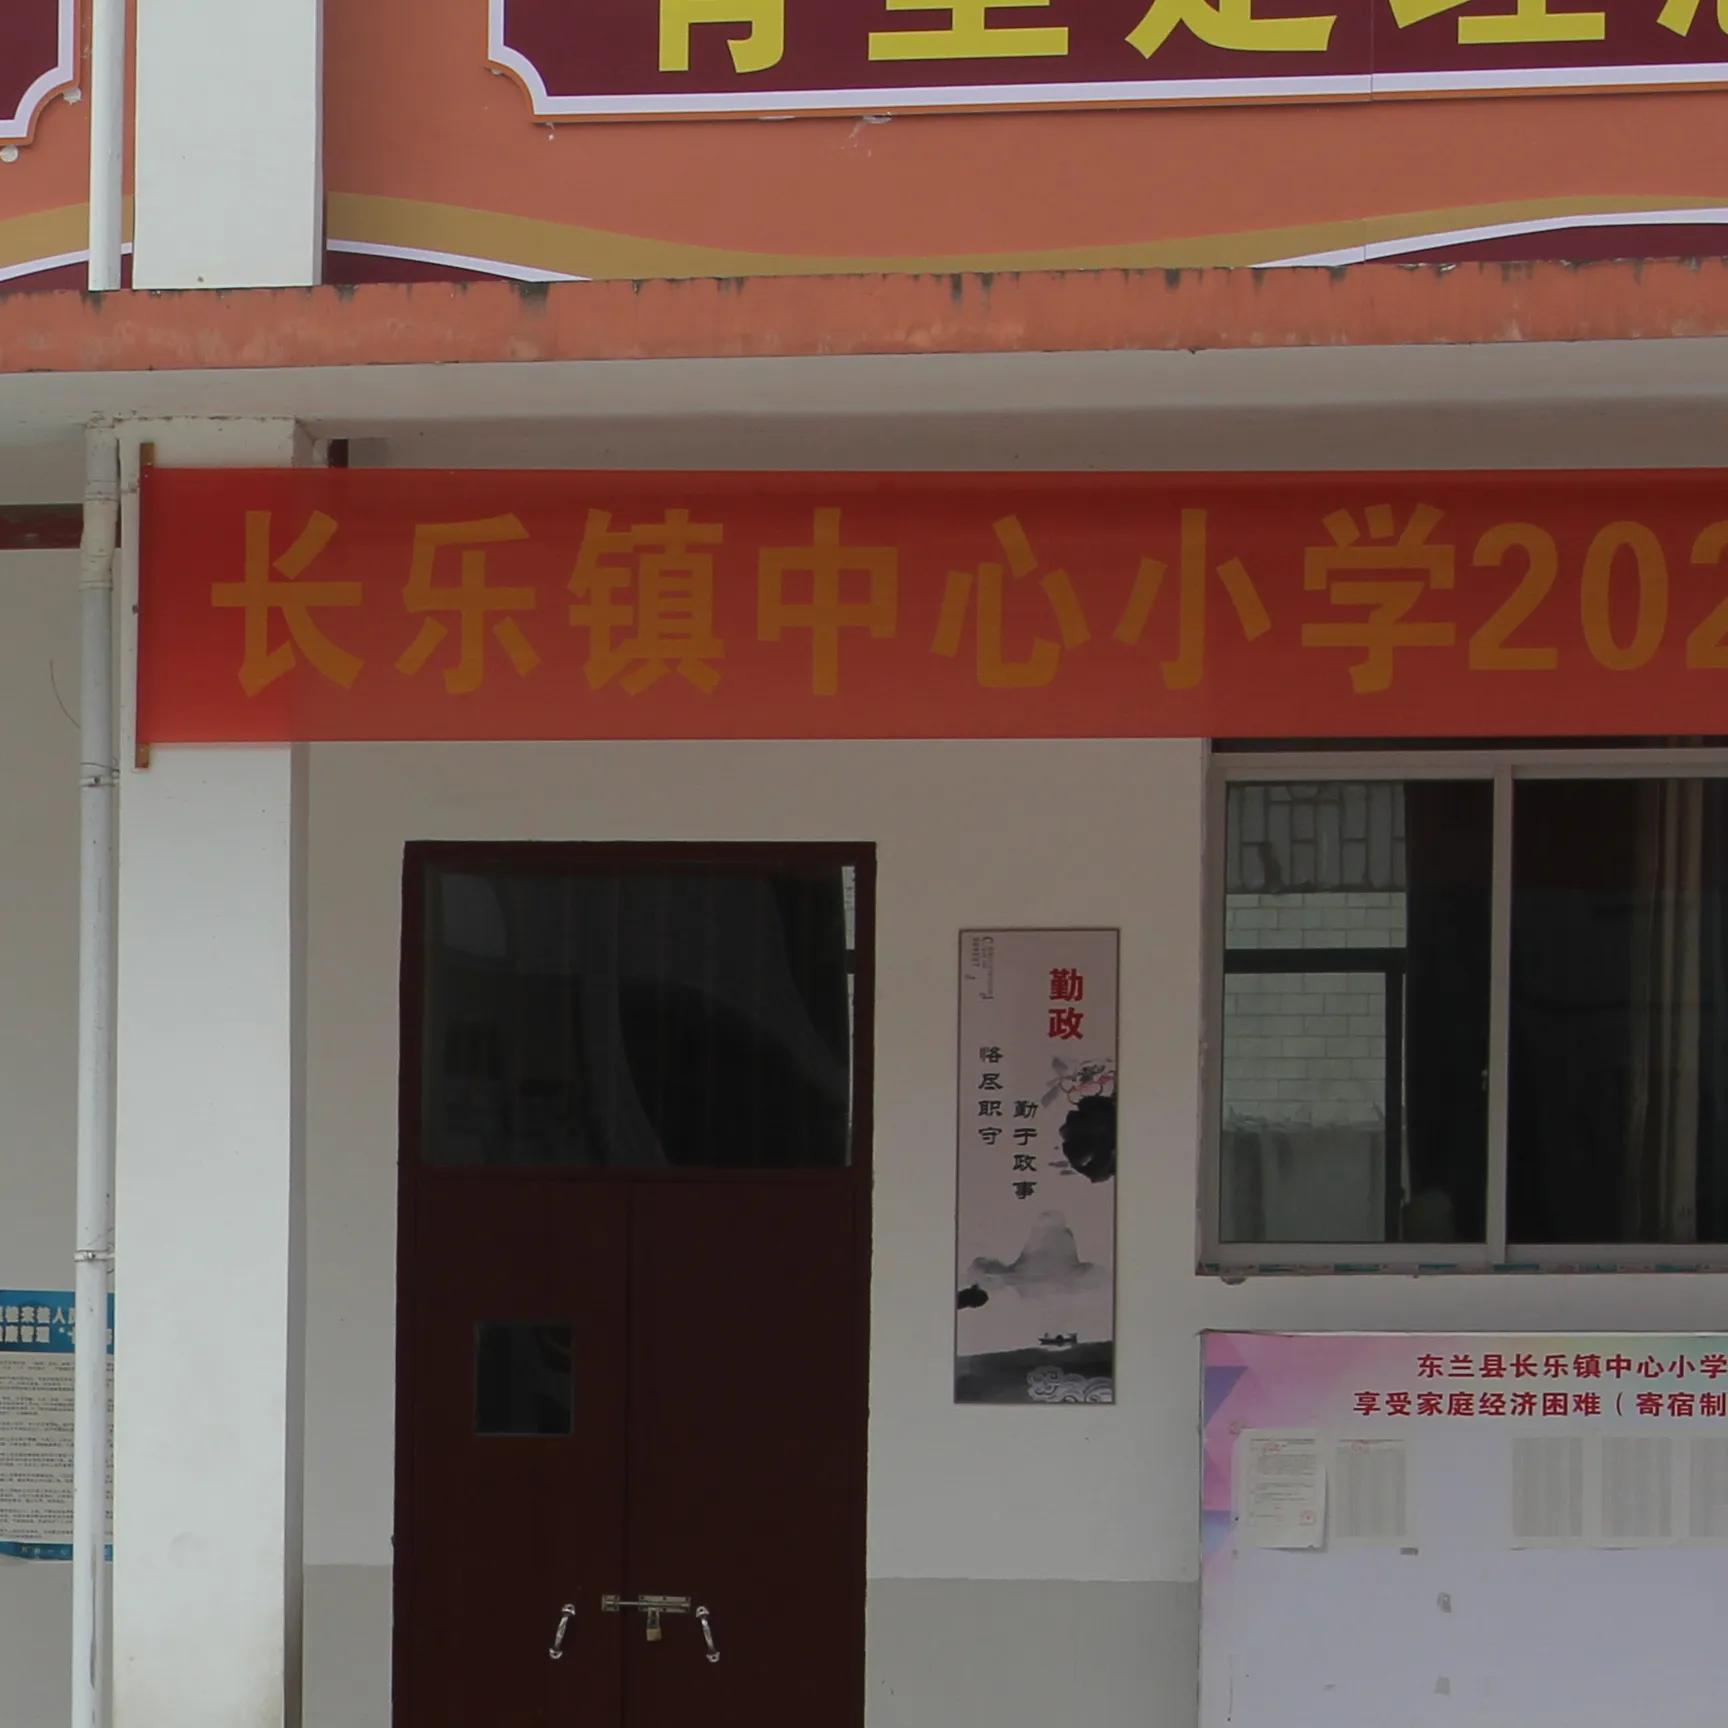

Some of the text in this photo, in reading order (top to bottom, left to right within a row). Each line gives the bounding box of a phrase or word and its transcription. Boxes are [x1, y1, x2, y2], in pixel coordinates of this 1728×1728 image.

[1047, 967, 1084, 1041] 勤政
[977, 1045, 1003, 1146] 恪尽职守
[1012, 1099, 1038, 1200] 勤于政事
[1416, 1352, 1728, 1379] 东兰县长乐镇中心小学
